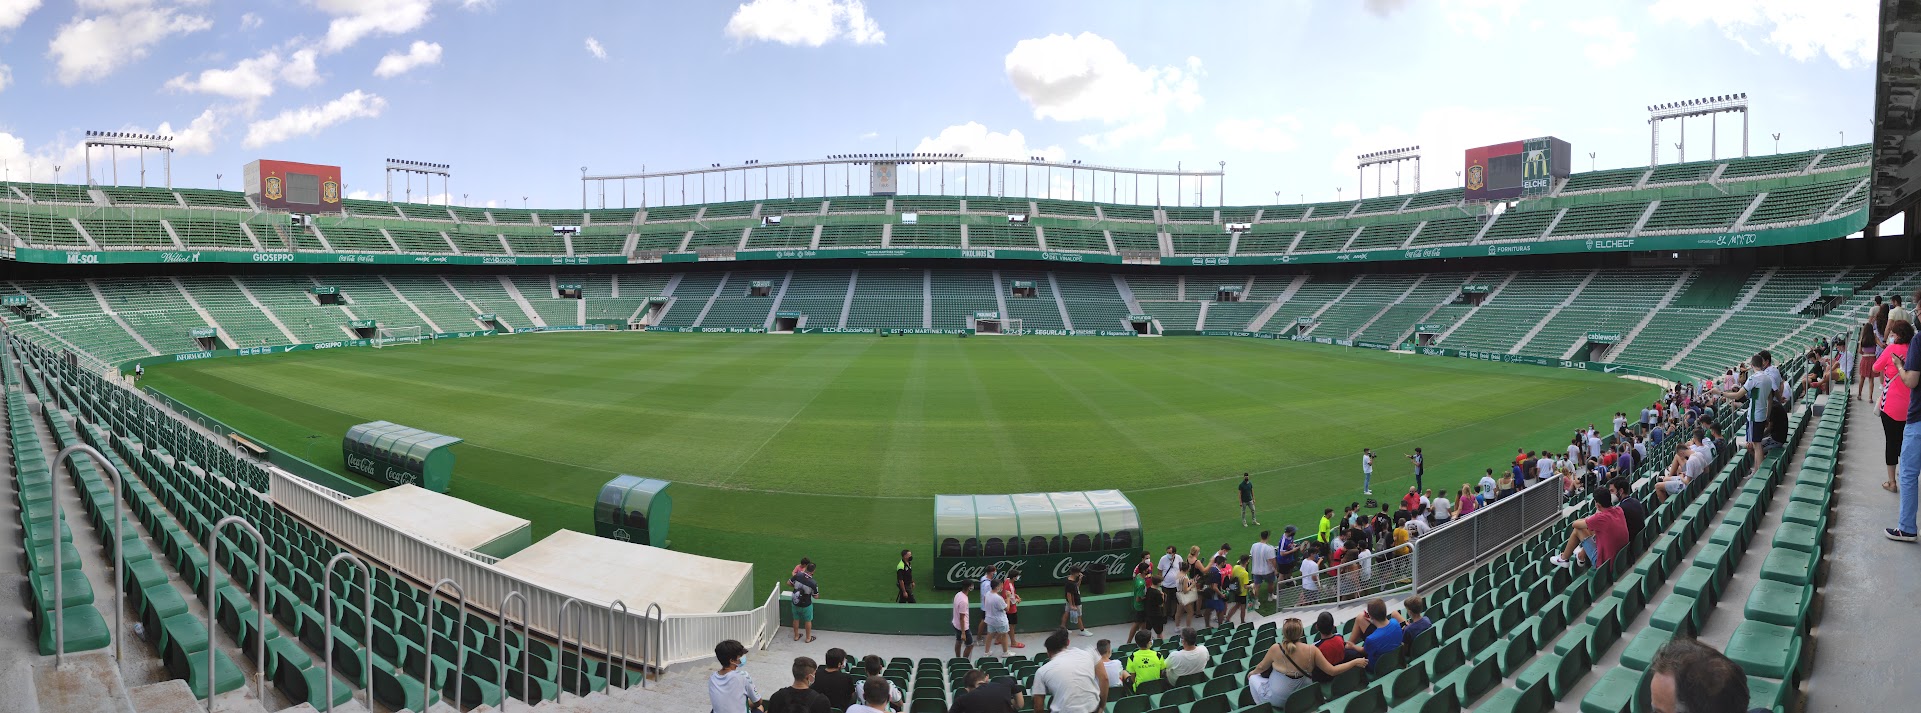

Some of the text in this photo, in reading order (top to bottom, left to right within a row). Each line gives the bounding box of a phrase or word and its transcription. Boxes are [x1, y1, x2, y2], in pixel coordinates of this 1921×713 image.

[1524, 180, 1547, 188] ELCHE
[1595, 240, 1635, 248] ELCHECF
[1716, 236, 1727, 245] EL
[67, 254, 99, 263] MI-SOL
[252, 253, 294, 262] GIOSEPPO
[1587, 332, 1620, 340] cableworld
[176, 351, 212, 360] INFORMACIÓN
